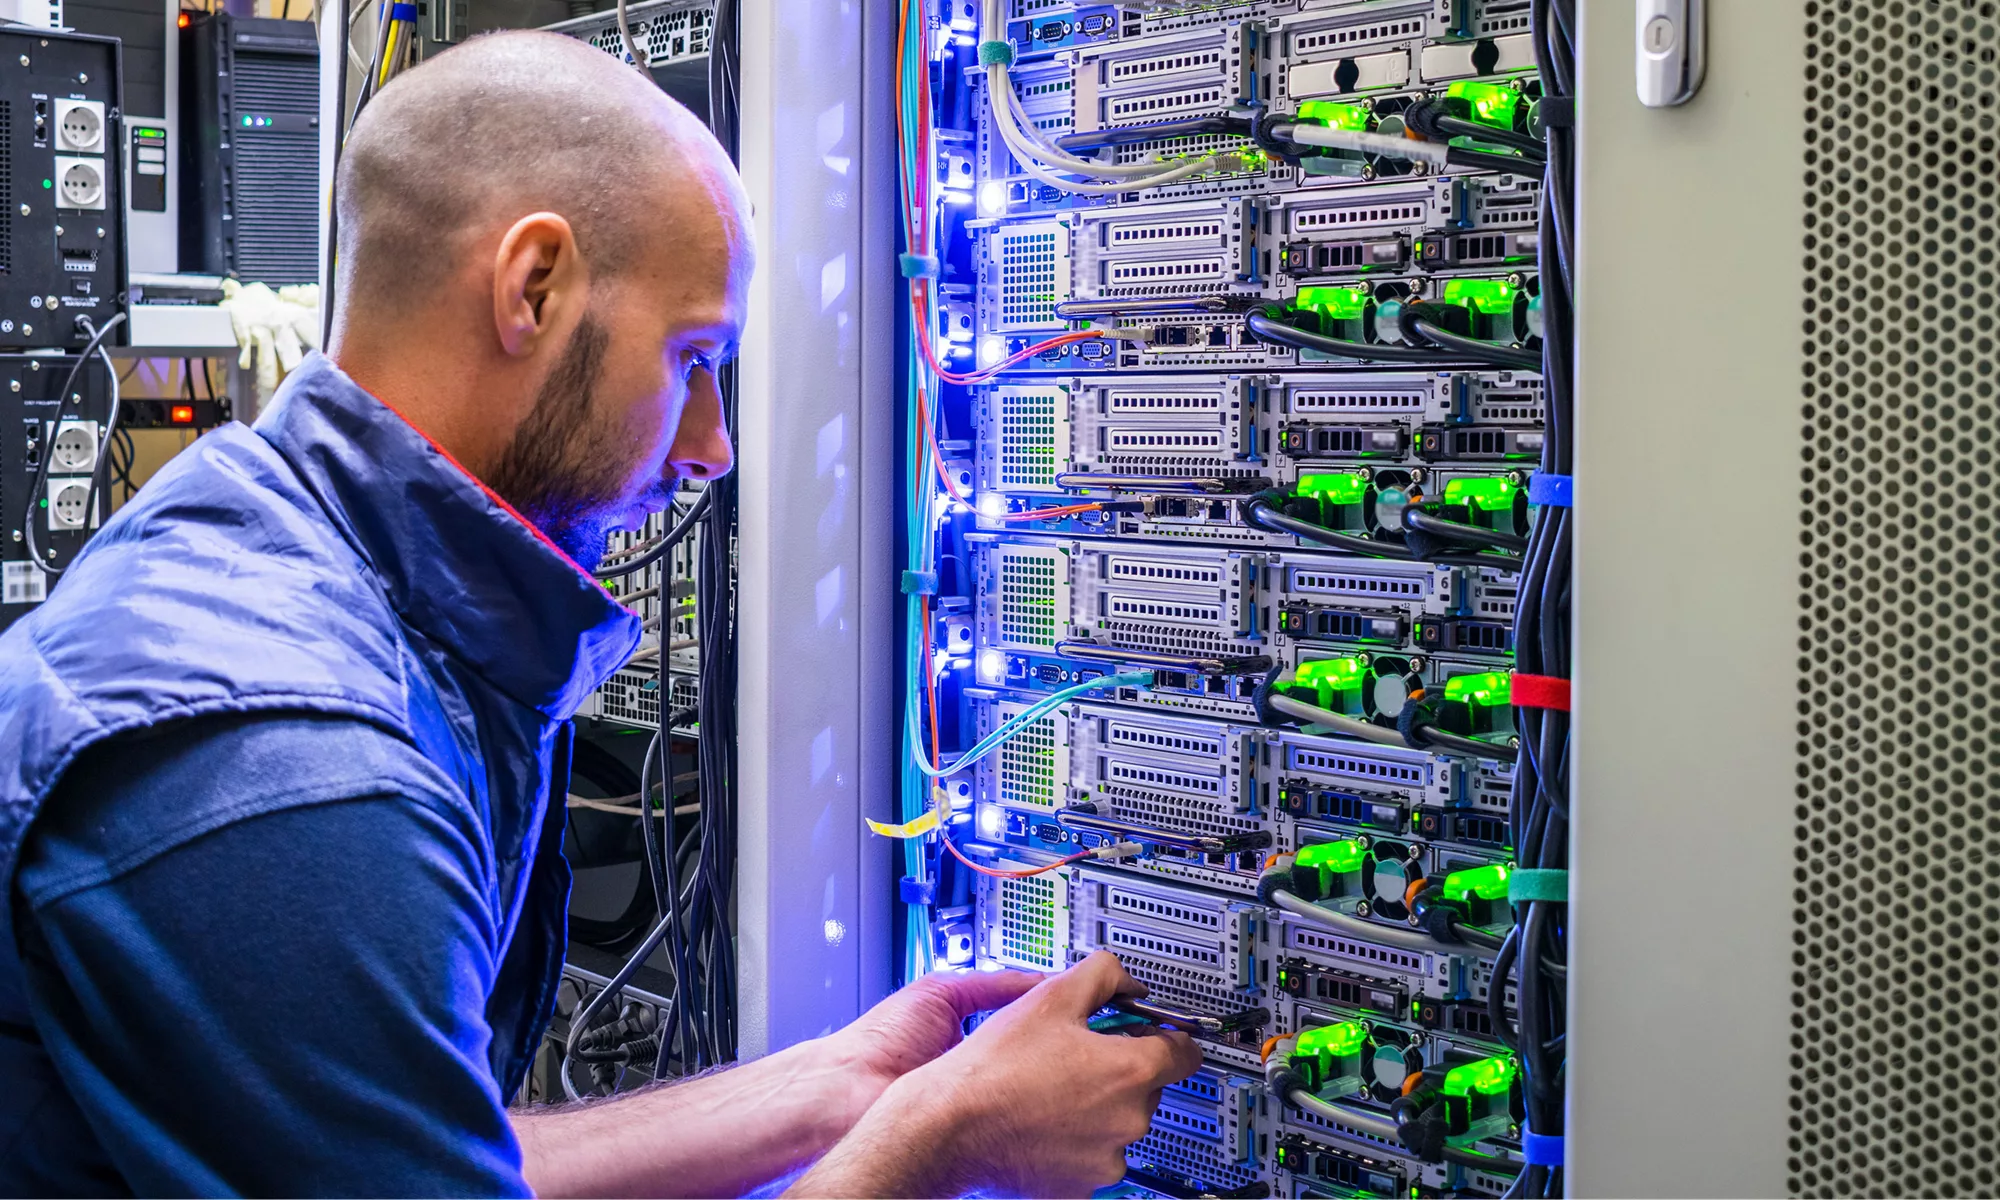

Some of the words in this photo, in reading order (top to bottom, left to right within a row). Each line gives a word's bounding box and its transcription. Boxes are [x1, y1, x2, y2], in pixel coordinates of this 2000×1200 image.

[1441, 0, 1449, 9] 6
[1232, 30, 1239, 42] 4
[1232, 72, 1238, 83] 5
[1441, 188, 1450, 201] 6
[1232, 207, 1240, 218] 4
[1232, 248, 1240, 259] 5
[1276, 290, 1284, 300] 1
[1231, 385, 1239, 397] 4
[1441, 384, 1450, 395] 6
[1231, 427, 1238, 438] 5
[1277, 470, 1283, 481] 1
[1231, 564, 1239, 575] 4
[1440, 577, 1449, 589] 6
[1231, 604, 1238, 616] 5
[1276, 649, 1283, 660] 1
[1232, 740, 1239, 751] 4
[1440, 770, 1448, 781] 6
[1231, 781, 1238, 792] 5
[1276, 824, 1282, 836] 1
[1230, 918, 1238, 929] 4
[1230, 958, 1237, 970] 5
[1439, 962, 1448, 975] 6
[1275, 1002, 1281, 1014] 1
[1230, 1094, 1236, 1104] 4
[1229, 1133, 1236, 1144] 5
[1274, 1178, 1280, 1190] 1
